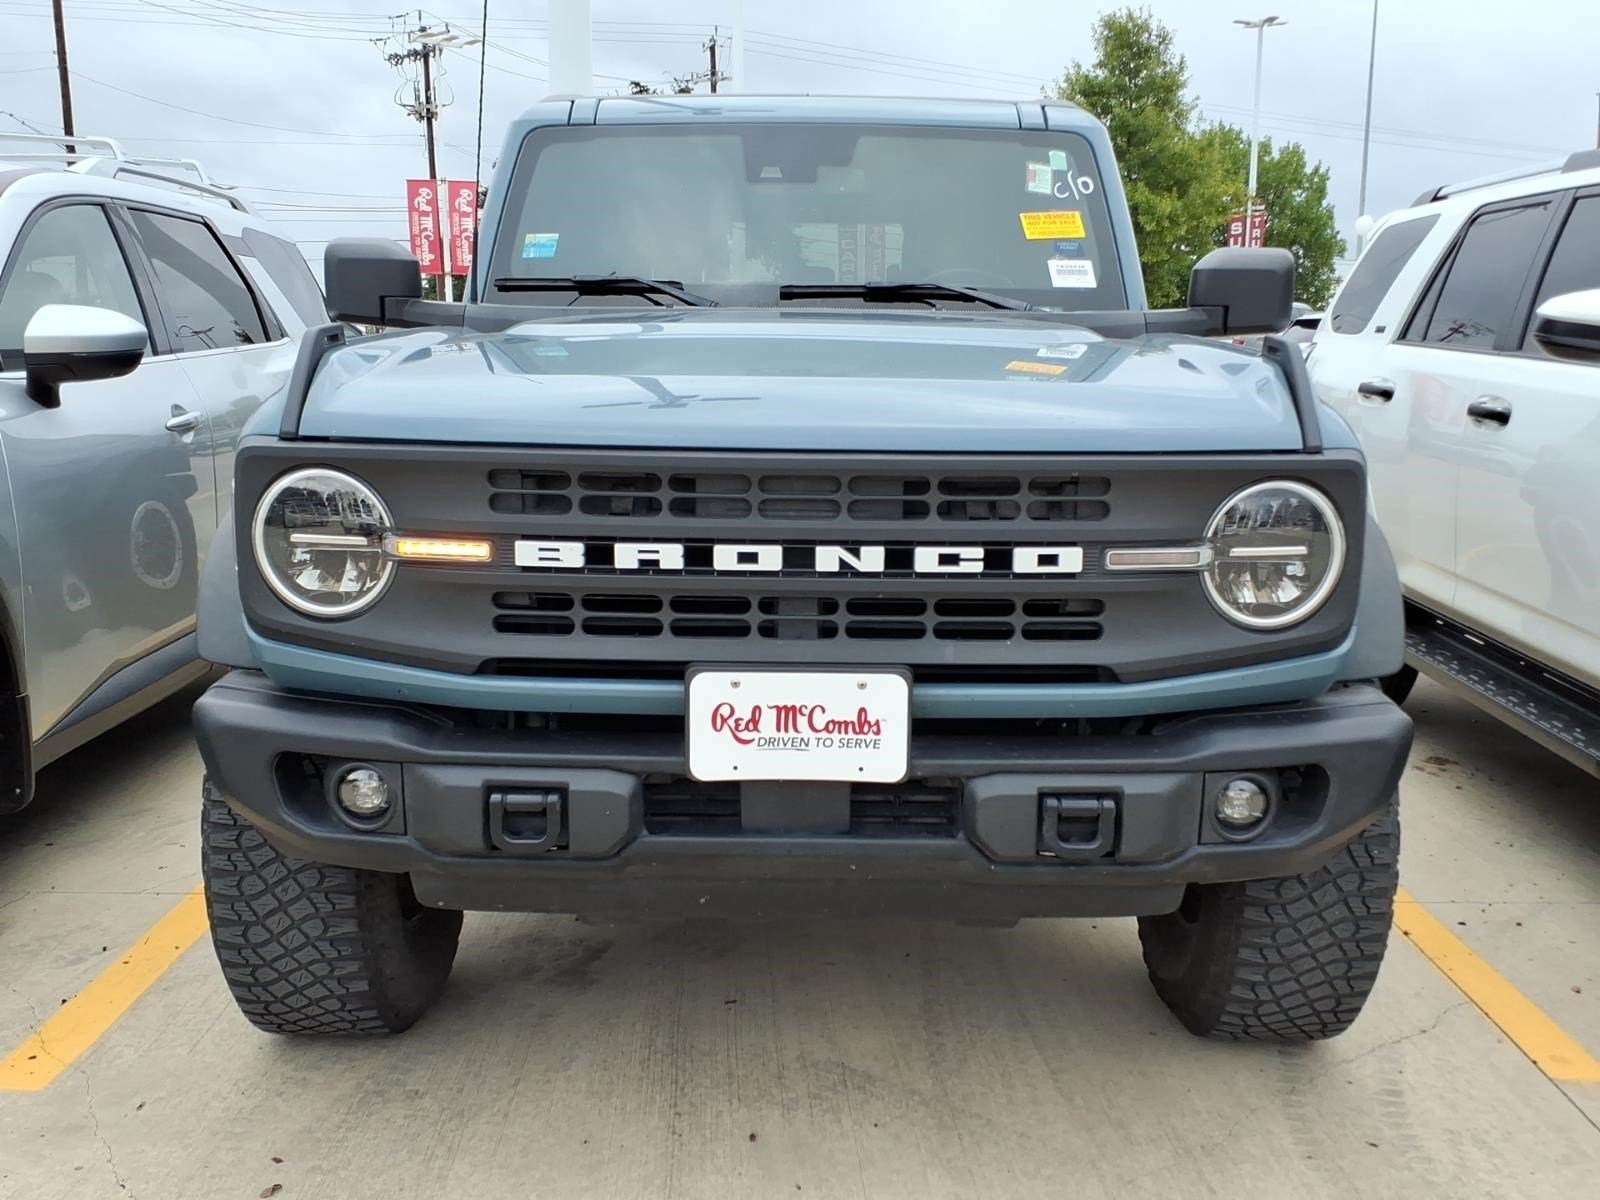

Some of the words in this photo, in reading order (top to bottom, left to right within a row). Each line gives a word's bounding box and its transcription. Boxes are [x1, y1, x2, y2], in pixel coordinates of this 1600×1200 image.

[413, 187, 433, 212] Red
[454, 188, 474, 213] Red
[419, 212, 436, 267] McCombs
[514, 540, 1084, 573] BRONCO
[711, 702, 762, 745] Red
[766, 704, 882, 736] McCombs
[756, 736, 811, 748] DRIVEN
[815, 737, 834, 748] TO
[838, 737, 882, 750] SERVE
